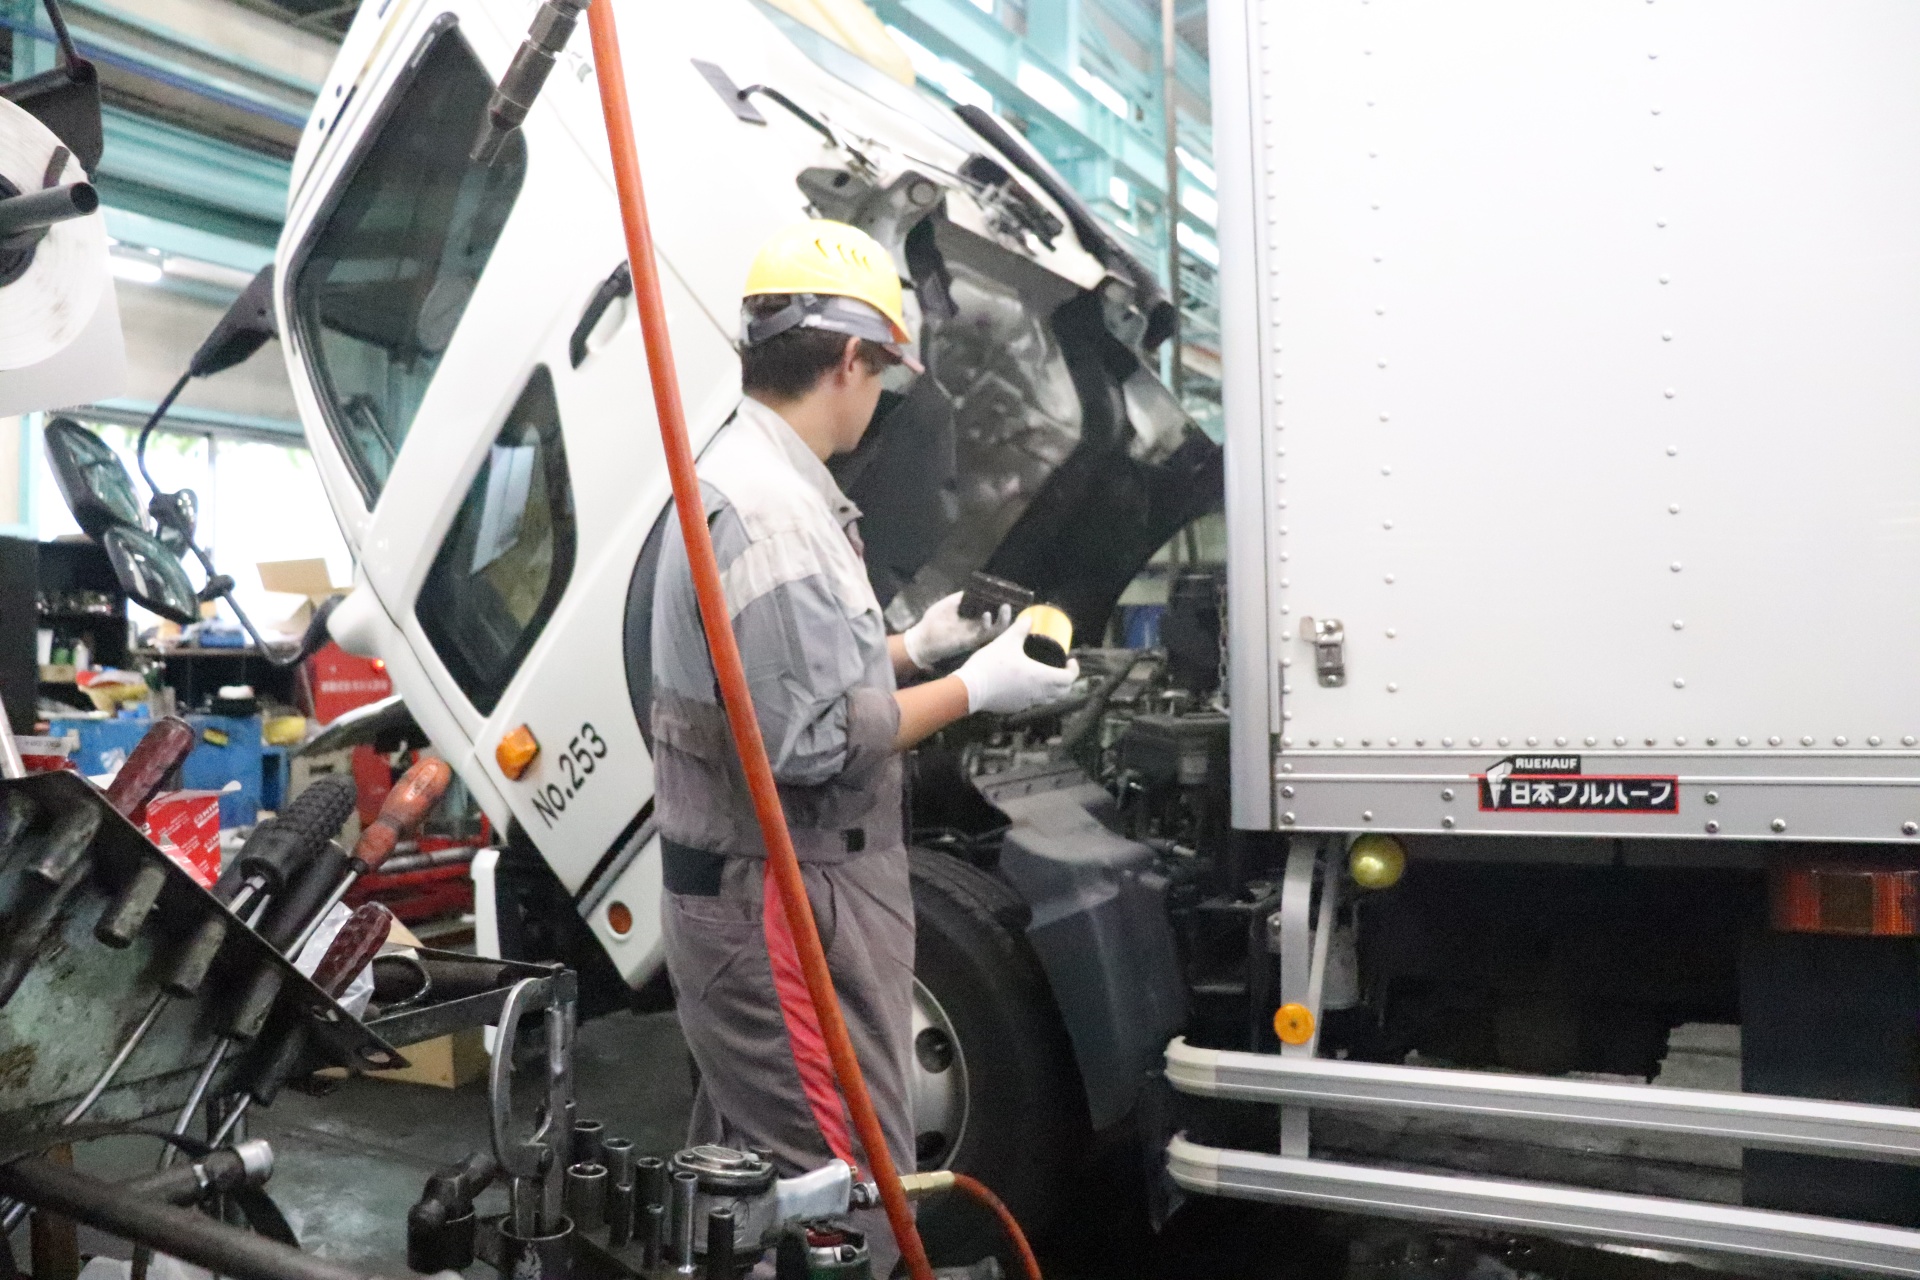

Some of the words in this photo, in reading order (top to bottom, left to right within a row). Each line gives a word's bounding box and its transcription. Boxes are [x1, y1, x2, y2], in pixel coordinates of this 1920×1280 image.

[1511, 782, 1672, 805] 日本フルハーフ
